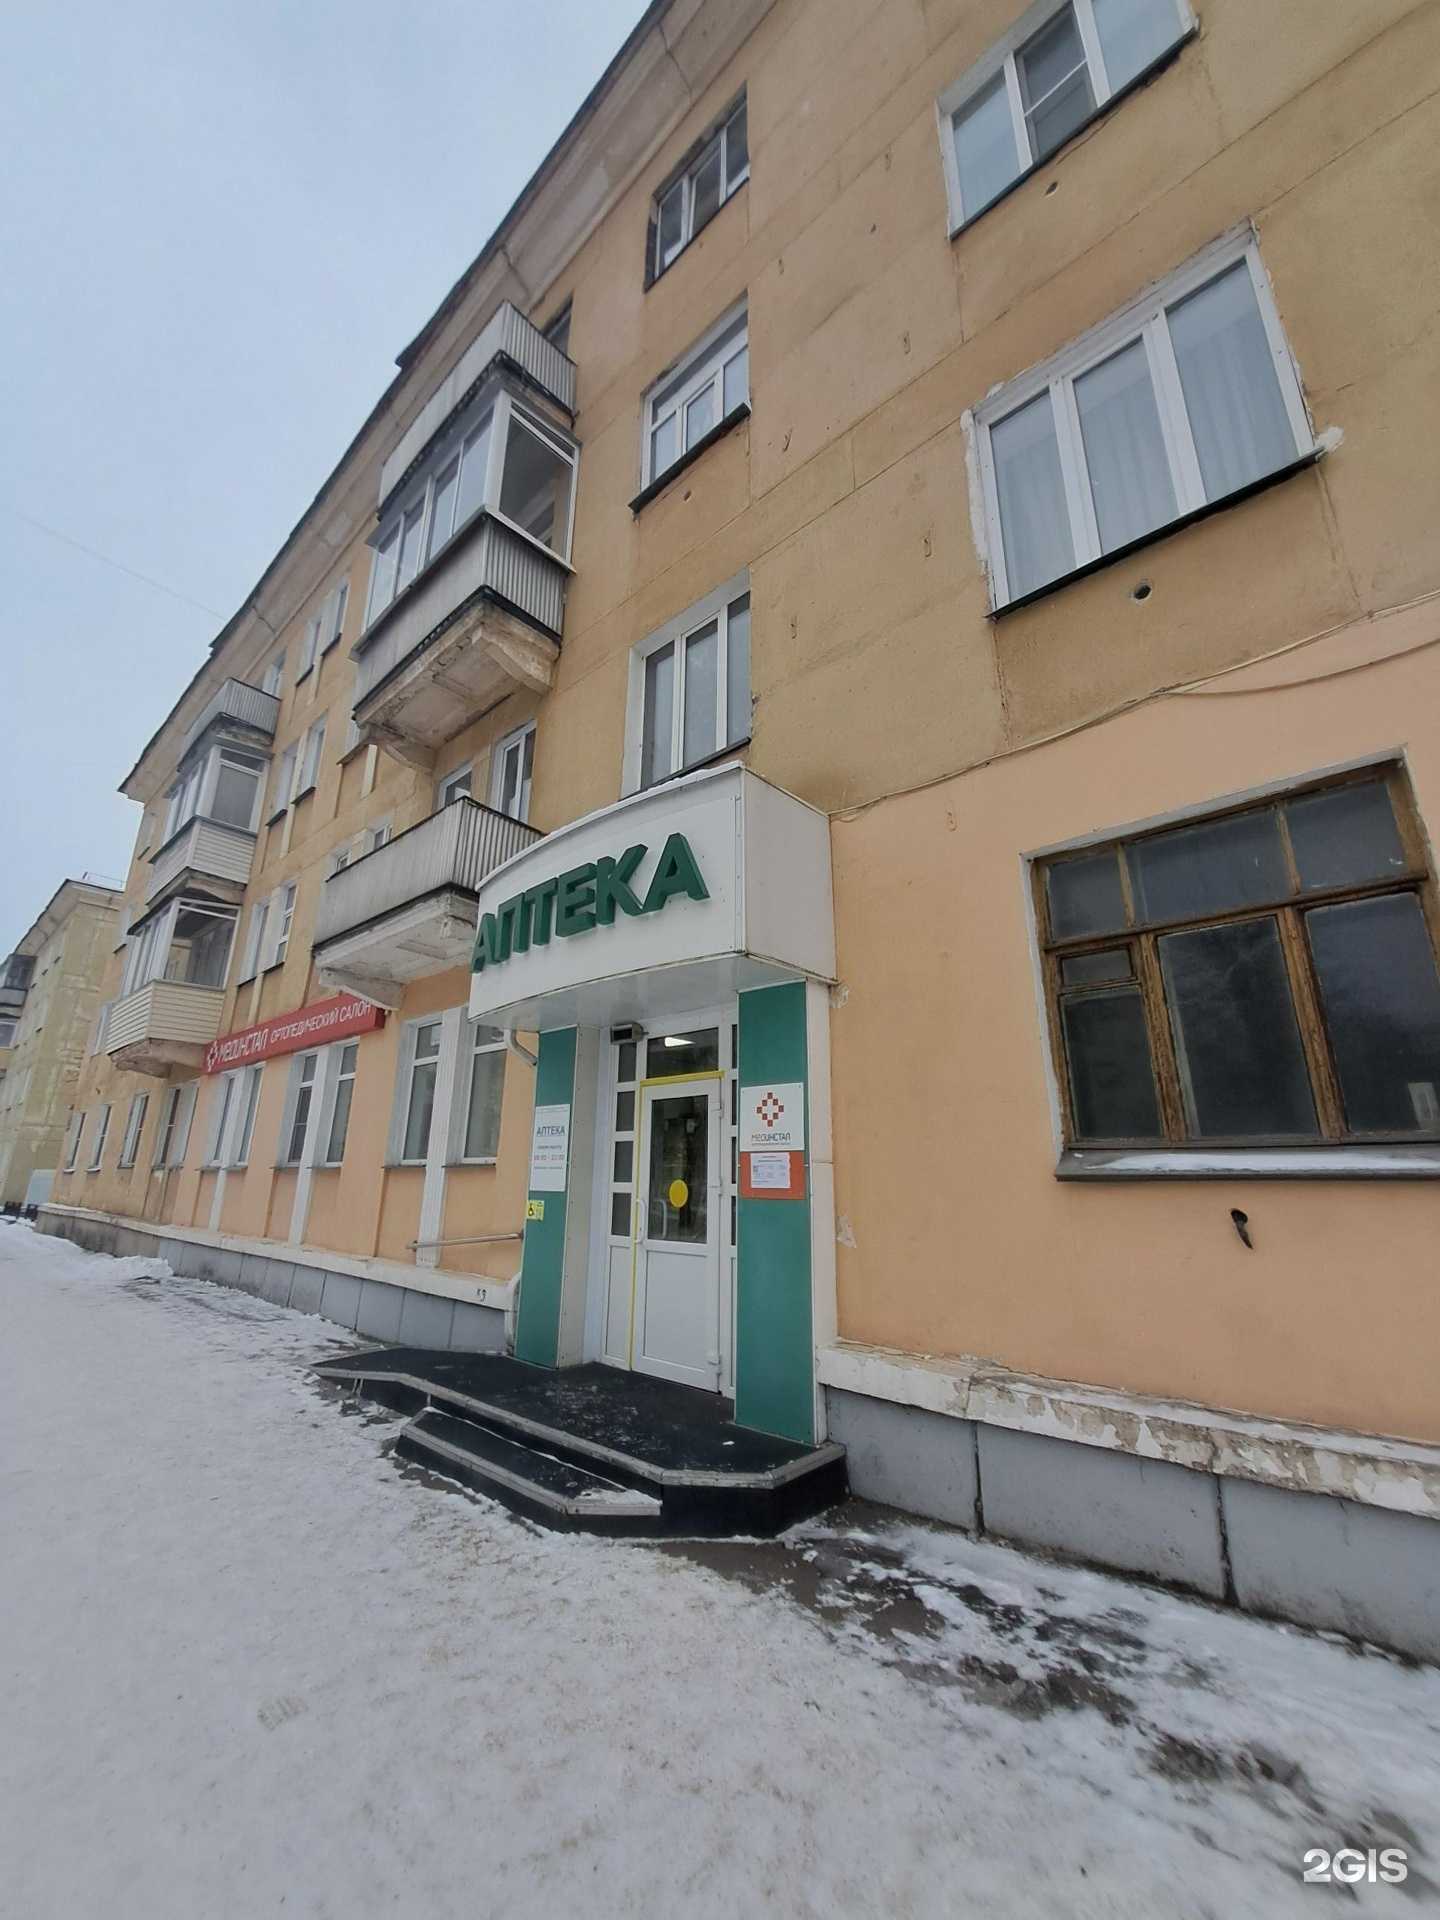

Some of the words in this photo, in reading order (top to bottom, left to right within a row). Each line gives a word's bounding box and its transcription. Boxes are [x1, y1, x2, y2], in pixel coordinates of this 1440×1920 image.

[471, 832, 711, 974] АПТЕКА
[339, 1000, 372, 1022] САЛОН
[536, 1126, 566, 1136] АПТЕКА
